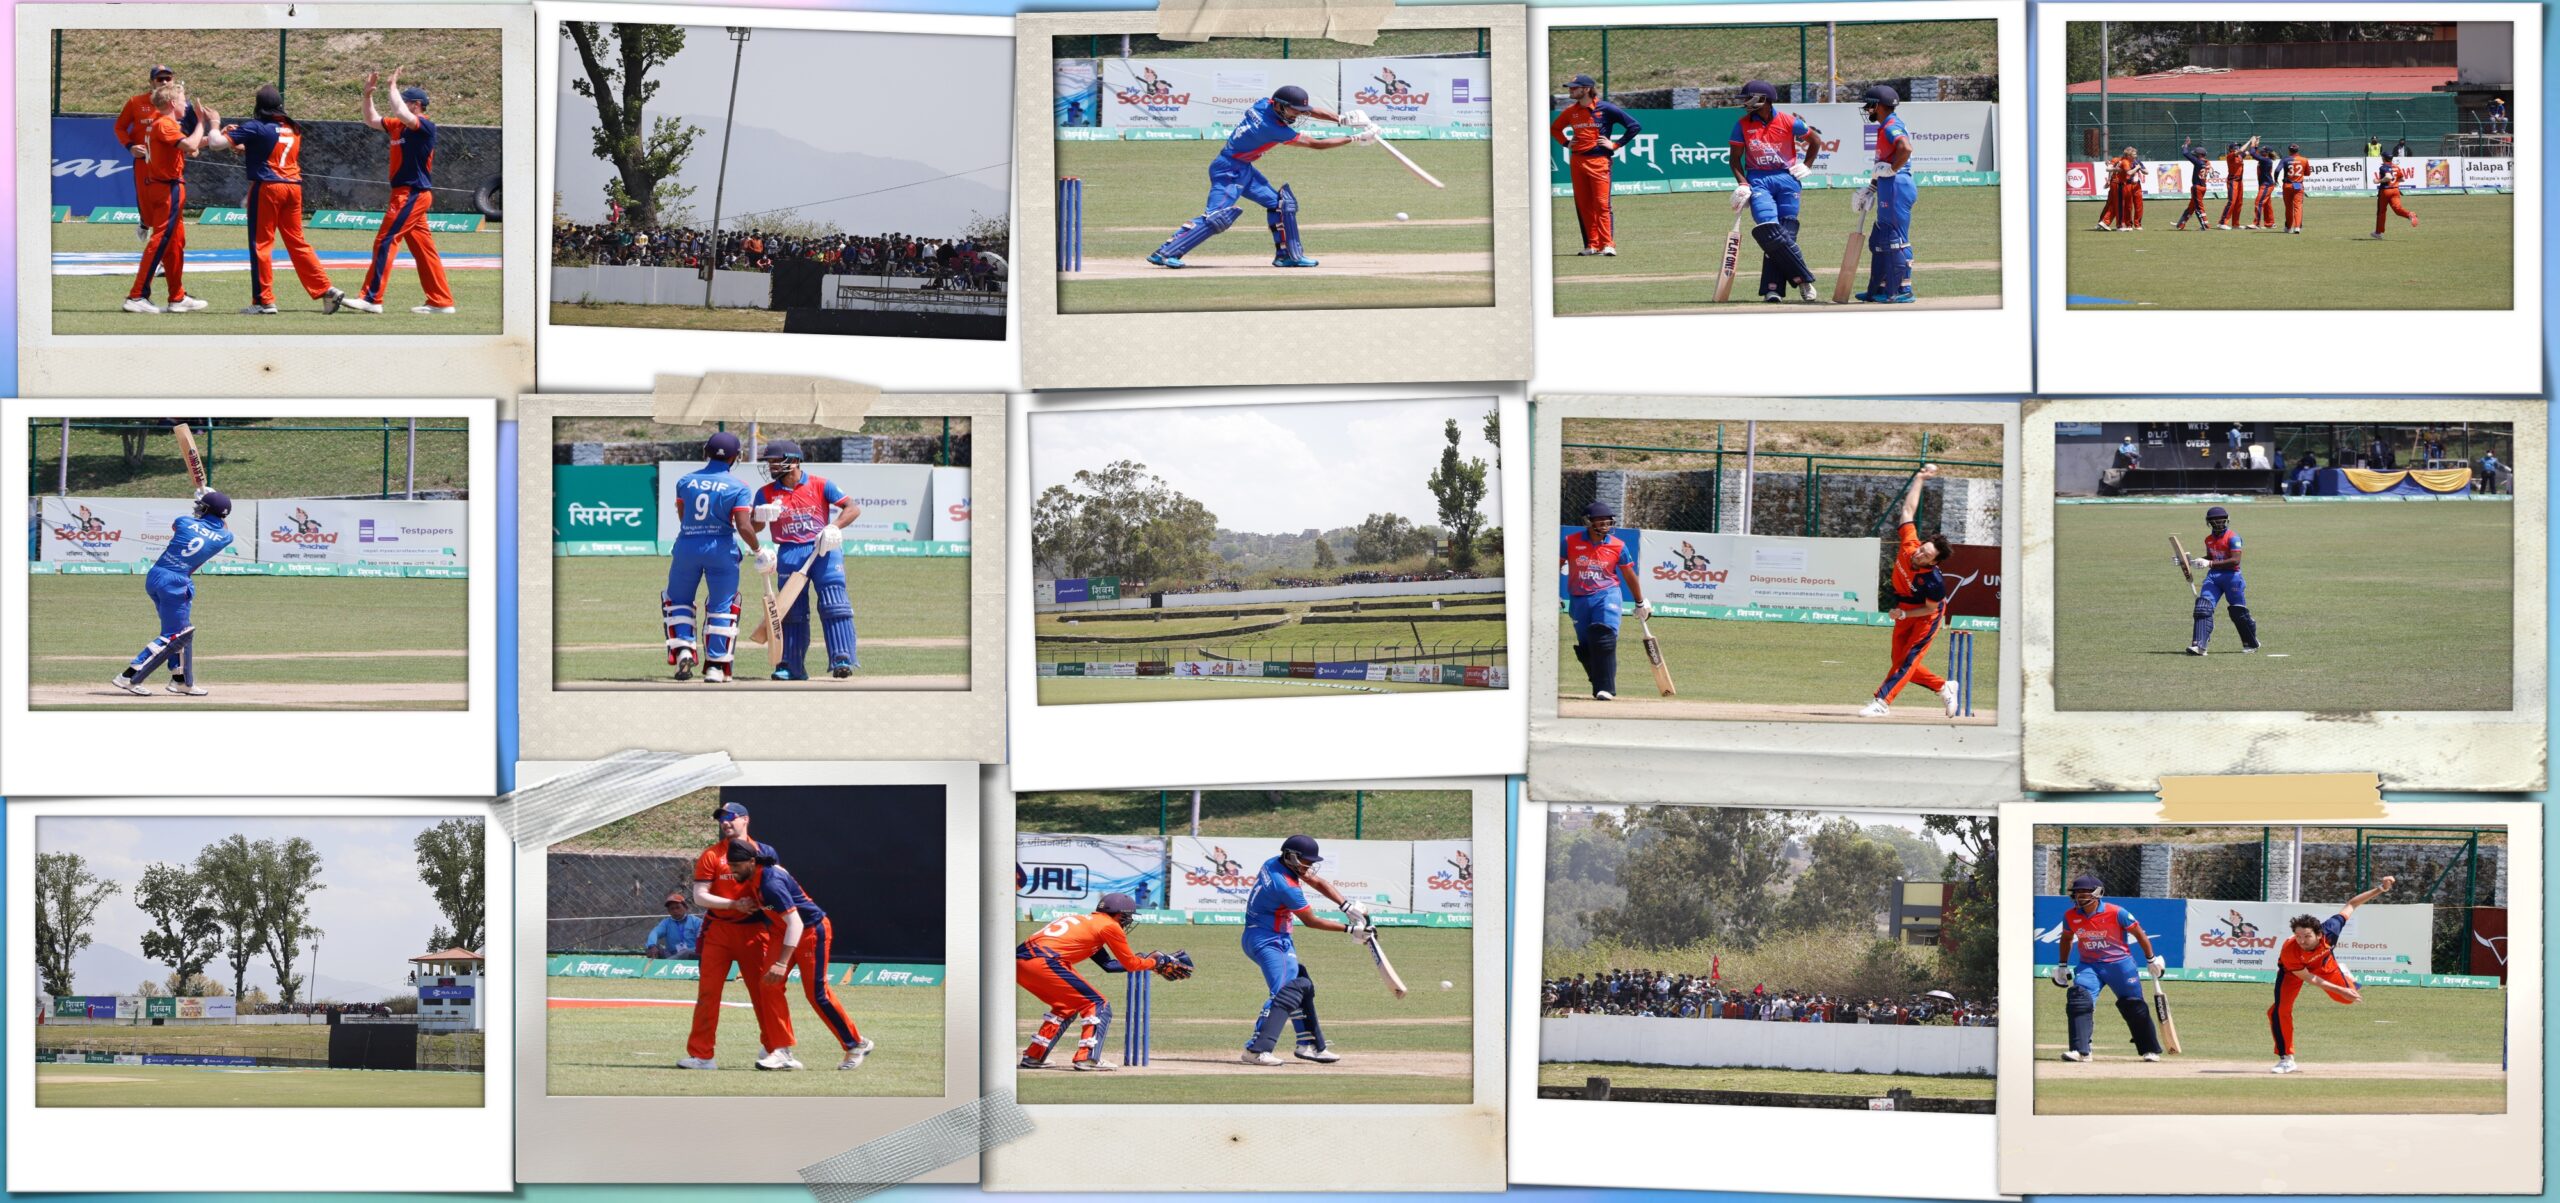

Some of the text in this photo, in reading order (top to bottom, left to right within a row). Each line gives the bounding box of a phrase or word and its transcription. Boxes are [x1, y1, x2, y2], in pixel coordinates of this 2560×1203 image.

[1125, 86, 1142, 95] My
[1364, 86, 1379, 95] My
[1116, 92, 1191, 106] Second
[1354, 92, 1430, 105] Second
[1147, 104, 1181, 112] Teacher
[1911, 131, 1970, 142] Testpapers
[277, 136, 294, 168] 7
[2287, 164, 2304, 176] 32
[2332, 161, 2363, 172] Fresh
[2466, 161, 2504, 173] Jalapa
[1725, 237, 1740, 270] PLAY ON!
[2147, 431, 2169, 439] D/L/S
[2185, 439, 2211, 448] OVERS
[2201, 447, 2210, 457] 2
[687, 478, 729, 492] ASIF
[694, 493, 709, 521] 9
[568, 501, 643, 527] सिमेन्ट
[187, 523, 223, 542] ASIF
[279, 525, 293, 534] My
[400, 526, 454, 536] Testpapers
[782, 520, 817, 534] NEPAL
[54, 528, 122, 542] Second
[141, 533, 172, 541] Diagno
[271, 530, 339, 544] Second
[180, 536, 205, 557] 9
[1663, 560, 1678, 570] My
[1578, 570, 1604, 581] NEPAL
[1652, 565, 1729, 584] Second
[1750, 574, 1836, 586] Diagnostic Reports
[1092, 585, 1115, 596] शिवम्
[1683, 581, 1718, 590] Teacher
[1194, 866, 1210, 875] My
[1437, 870, 1453, 880] My
[1026, 866, 1083, 895] JAL
[1333, 879, 1369, 889] Reports
[2210, 928, 2225, 937] My
[2200, 933, 2278, 949] Second
[2352, 941, 2388, 951] Reports
[2232, 947, 2267, 956] Teacher
[576, 961, 611, 976] शिवम्
[877, 969, 913, 985] शिवम्
[2364, 975, 2392, 985] शिवम्
[65, 1000, 87, 1010] शिवम्
[150, 1003, 172, 1013] शिवम्
